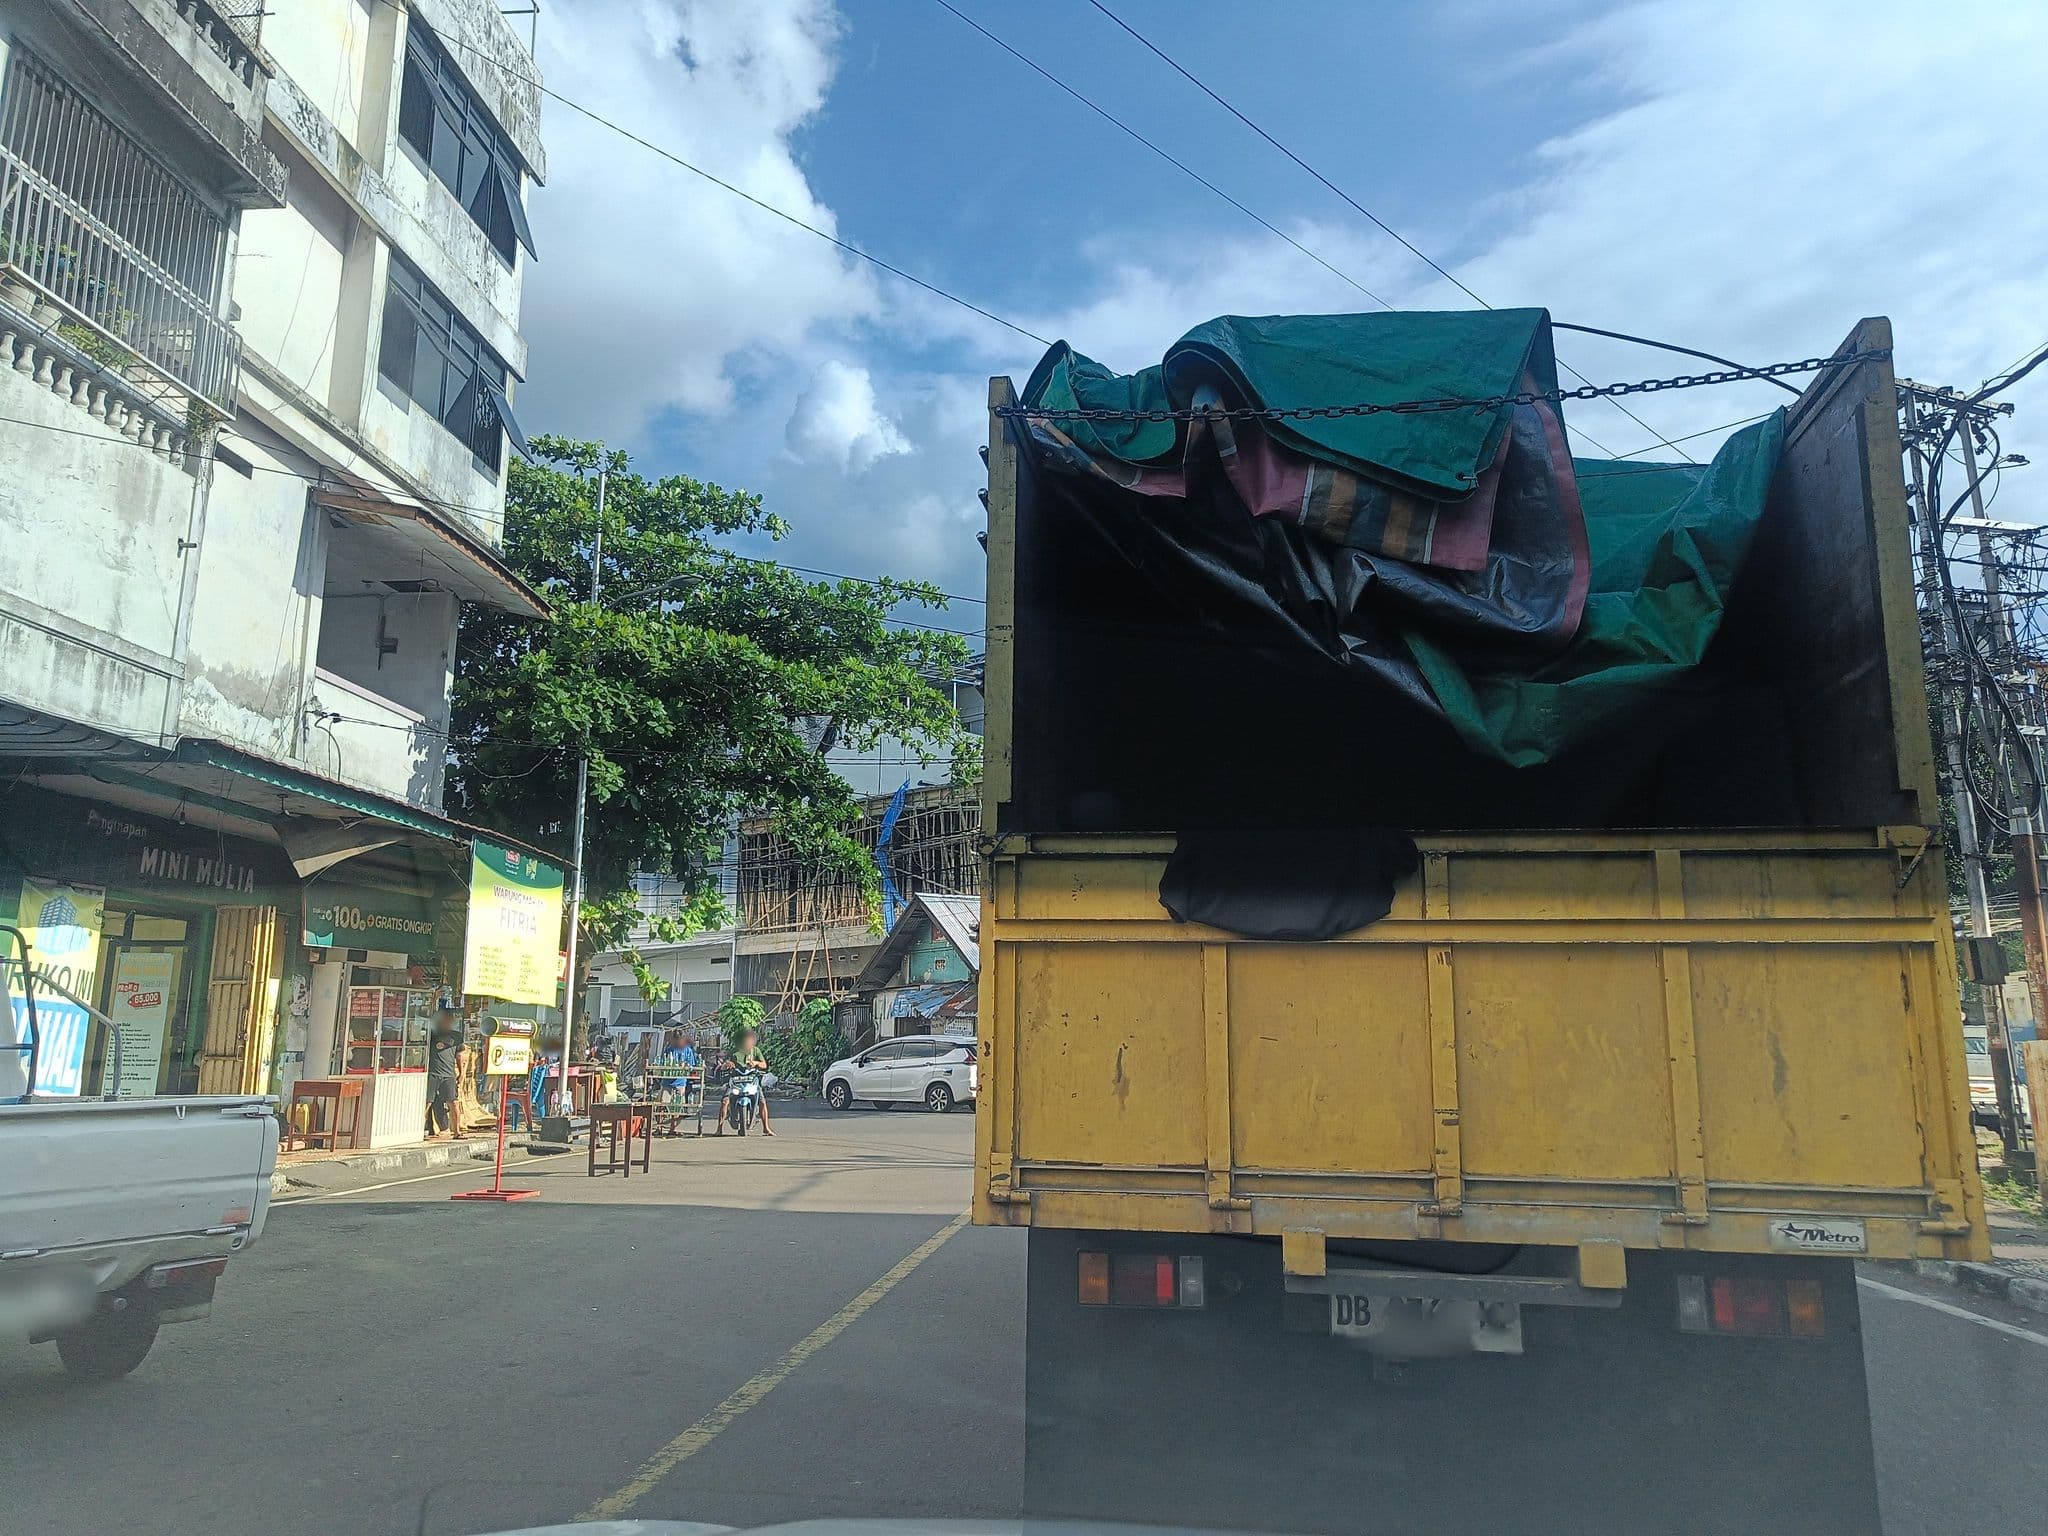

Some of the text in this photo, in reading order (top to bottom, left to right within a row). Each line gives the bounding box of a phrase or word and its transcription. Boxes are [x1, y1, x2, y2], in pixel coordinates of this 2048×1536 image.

[140, 847, 254, 894] MINI MULIA
[375, 915, 403, 931] GRATIS
[500, 906, 537, 935] FITRIA
[74, 968, 94, 1001] INI
[134, 992, 159, 1004] 65.000
[1803, 1228, 1860, 1243] Metro
[1336, 1294, 1371, 1326] DB
